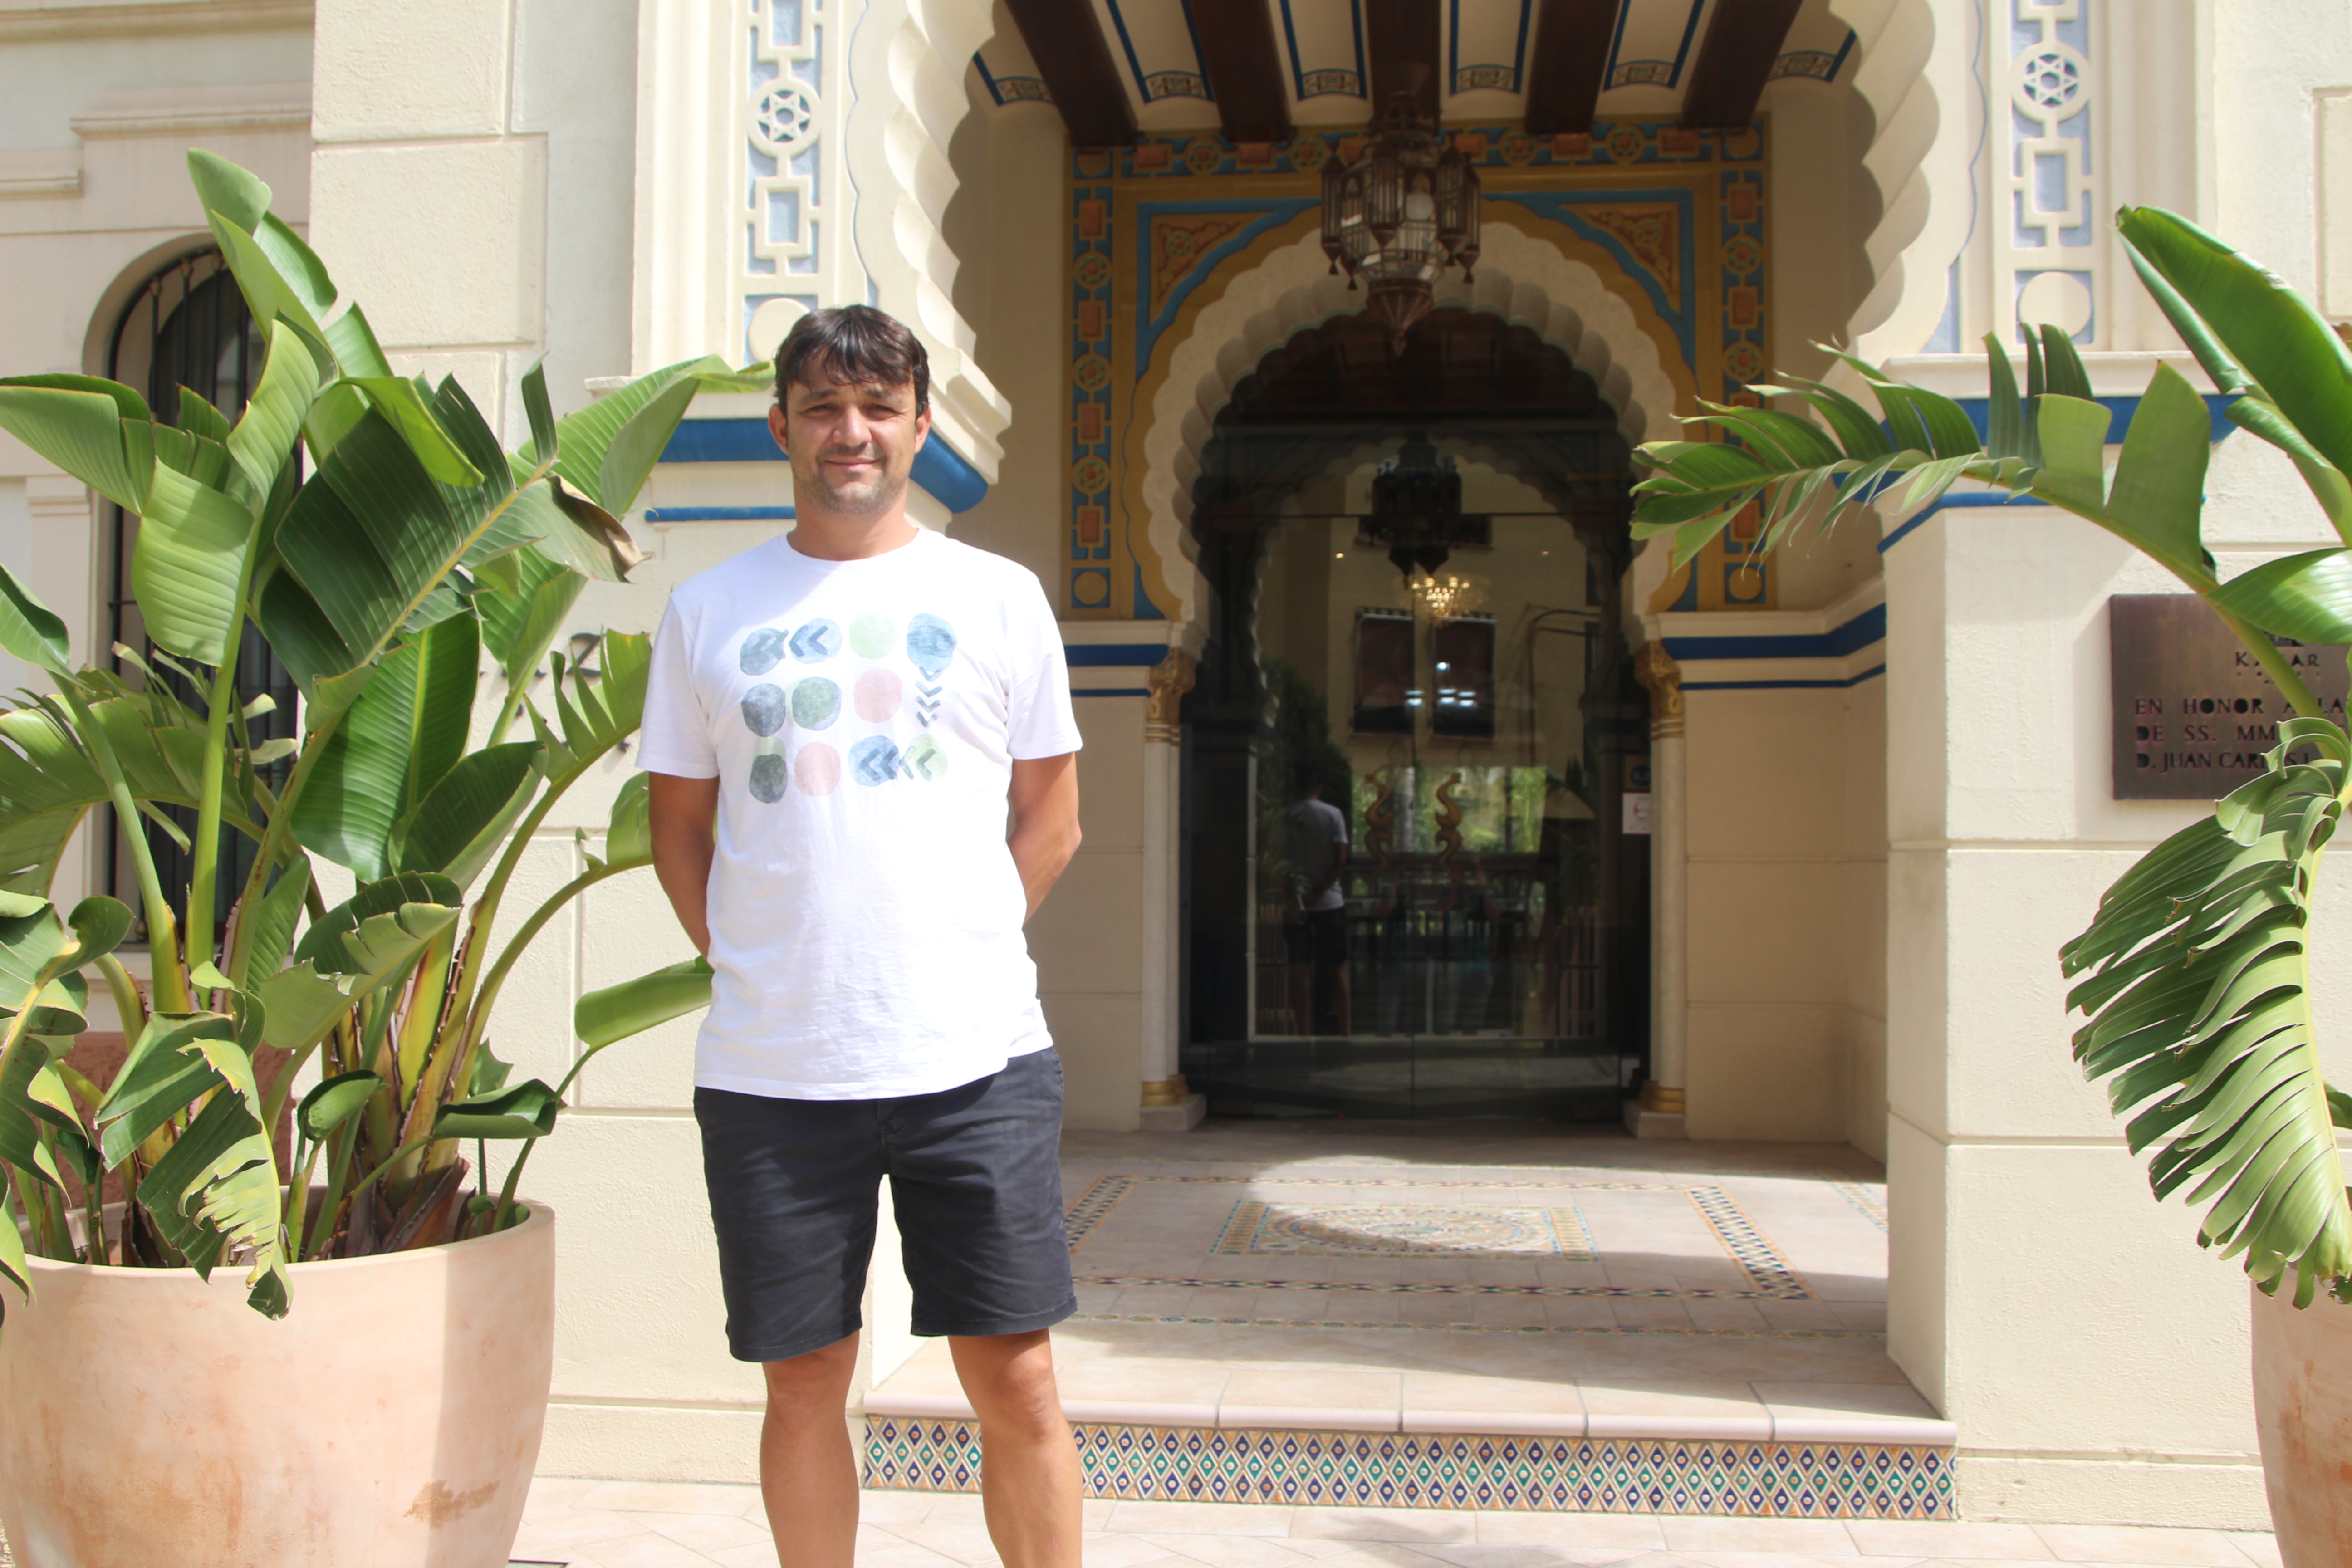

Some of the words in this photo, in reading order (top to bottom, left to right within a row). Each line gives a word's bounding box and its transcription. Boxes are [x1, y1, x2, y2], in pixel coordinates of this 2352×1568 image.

[2235, 652, 2320, 667] KAR
[2135, 699, 2163, 715] EN
[2184, 698, 2264, 714] HONOR
[2136, 726, 2164, 742] DE
[2185, 725, 2217, 742] SS.
[2136, 754, 2157, 769] D.
[2162, 753, 2212, 775] JUAN
[2219, 753, 2298, 769] CARLS
